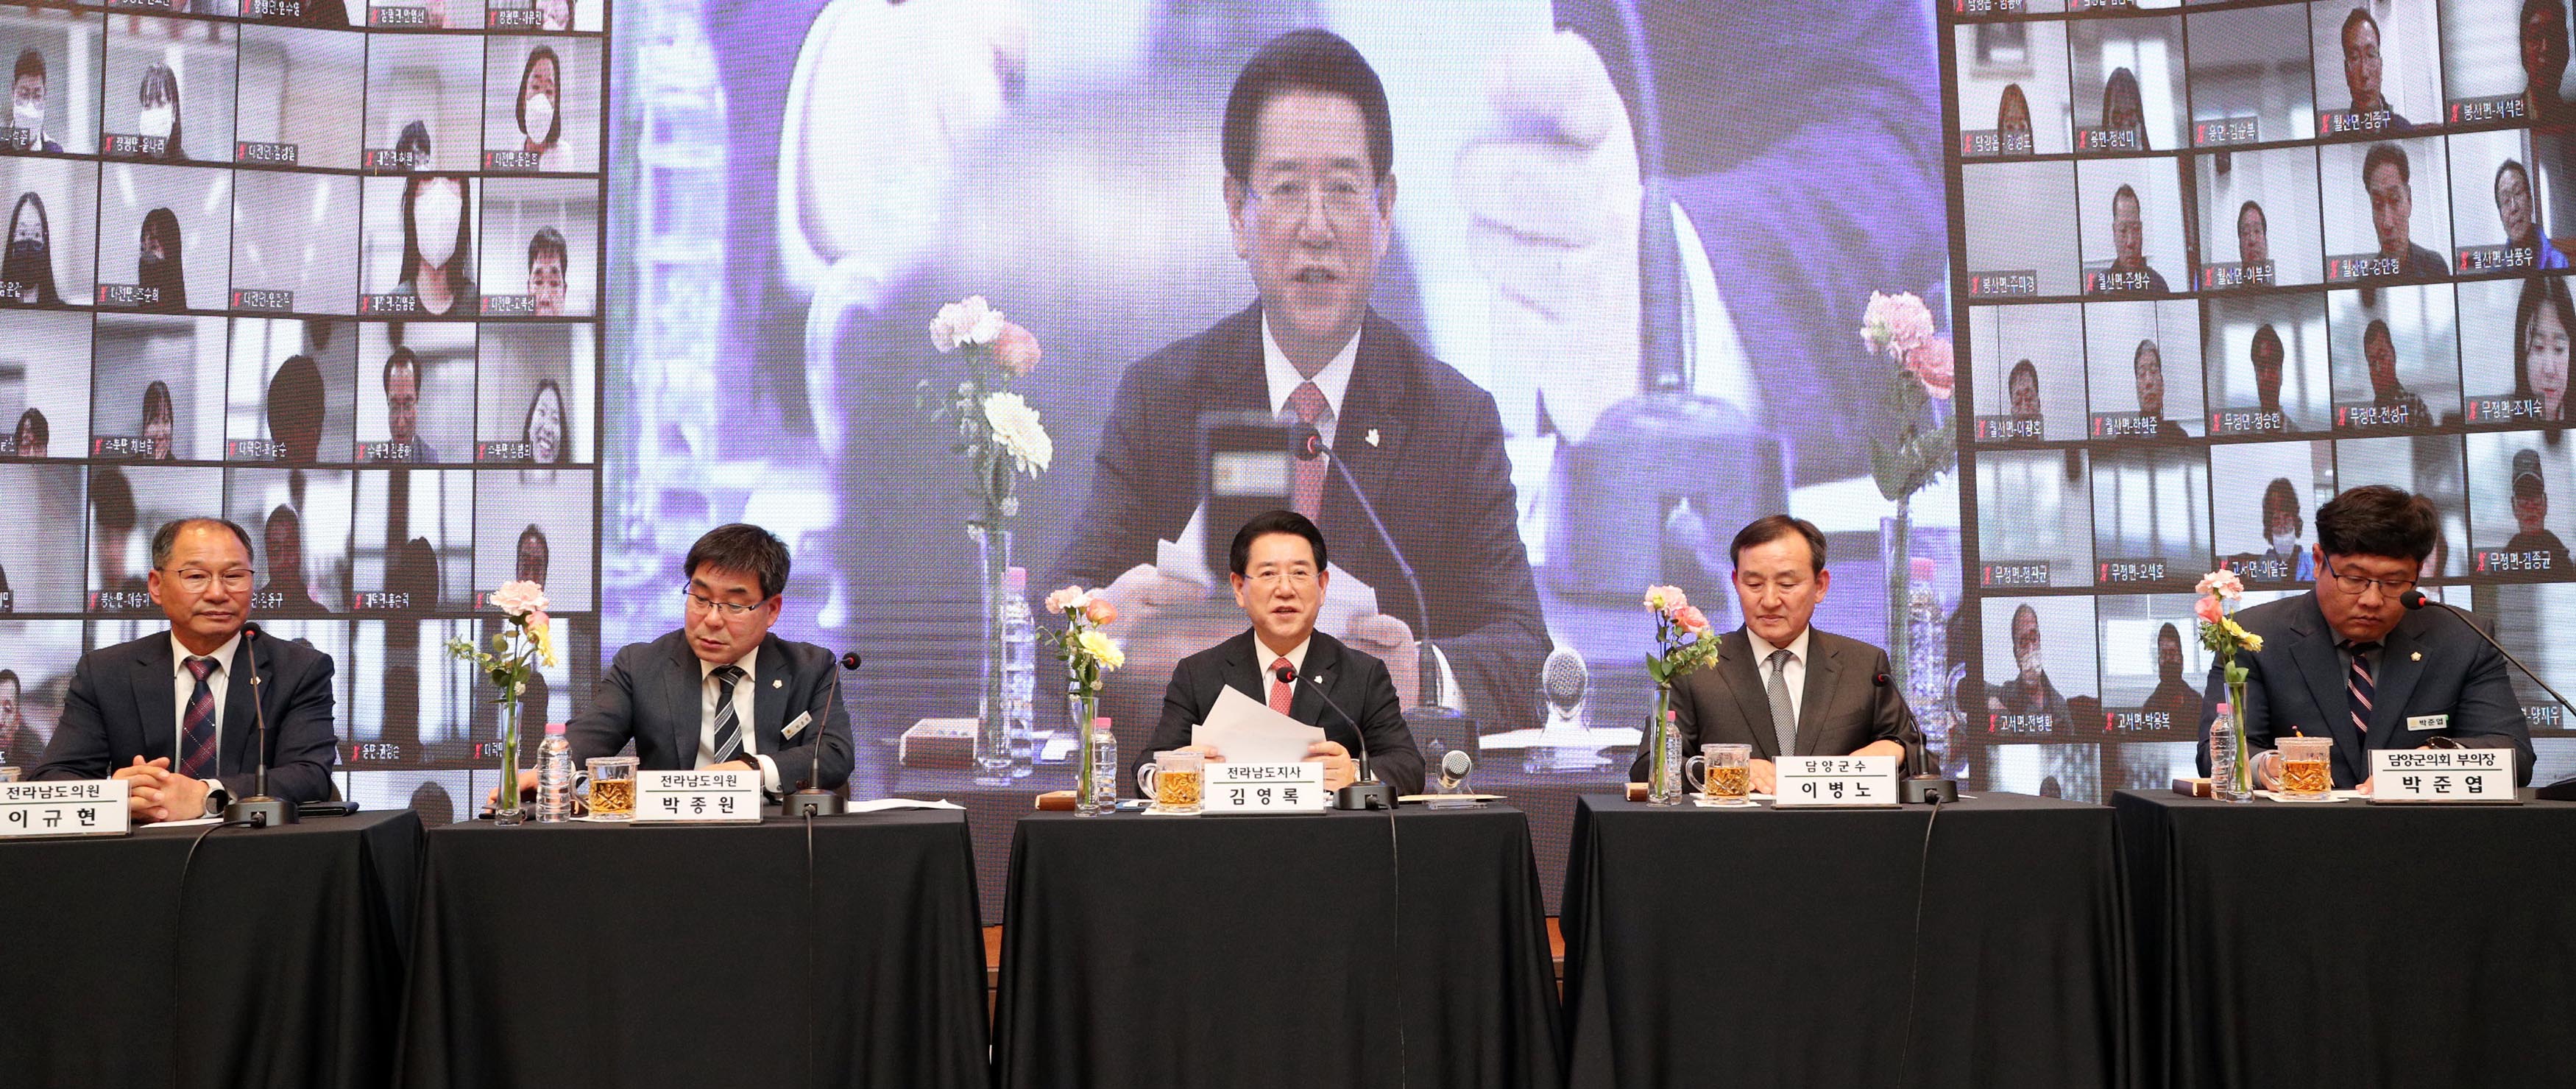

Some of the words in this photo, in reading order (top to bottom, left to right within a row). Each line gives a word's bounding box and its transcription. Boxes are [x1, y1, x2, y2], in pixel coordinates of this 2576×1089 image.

[2388, 753, 2450, 766] 담양군의회
[2457, 753, 2496, 766] 부의장
[1227, 766, 1301, 779] 전라남도지사
[1805, 760, 1866, 773] 담양군수
[660, 774, 737, 788] 전라남도의원
[6, 783, 100, 800] 전라남도의원
